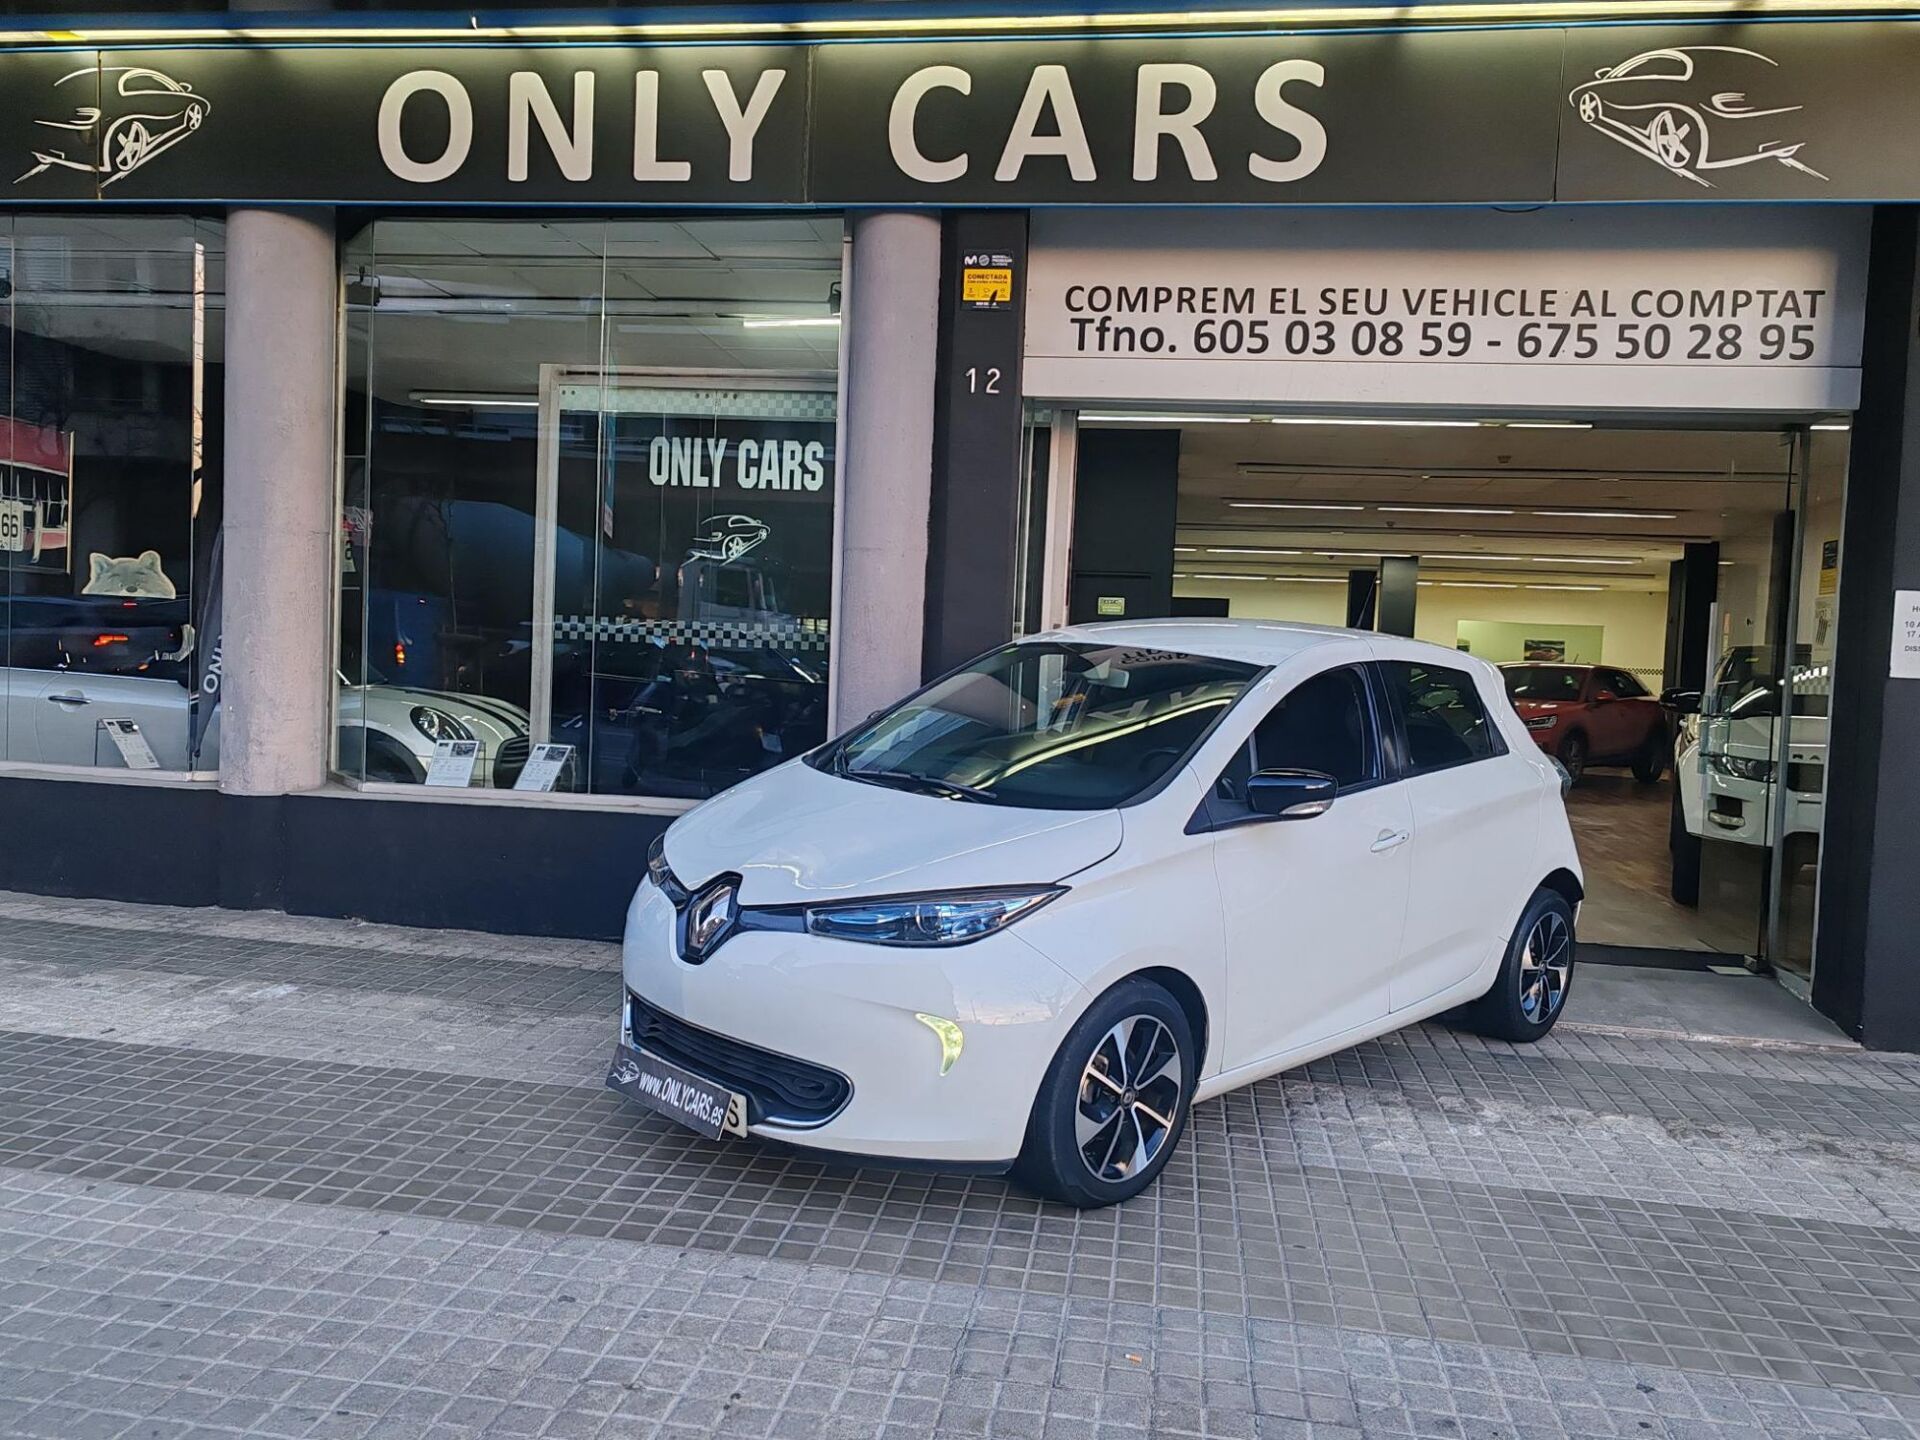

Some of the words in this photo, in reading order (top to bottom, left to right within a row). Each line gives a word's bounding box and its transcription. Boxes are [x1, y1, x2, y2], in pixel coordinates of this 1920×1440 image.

[378, 68, 786, 183] ONLY
[888, 60, 1327, 184] CARS
[1065, 285, 1255, 315] COMPREM
[1269, 287, 1307, 315] EL
[1318, 288, 1388, 316] SEU
[1402, 288, 1558, 317] VEHICLE
[1570, 290, 1617, 318] AL
[1631, 290, 1828, 320] COMPTAT
[1070, 317, 1177, 353] Tfno.
[1194, 319, 1269, 354] 605
[1285, 320, 1336, 355] 03
[1351, 321, 1404, 356] 08
[1419, 322, 1471, 357] 59
[1517, 322, 1598, 359] 675
[1615, 323, 1671, 360] 50
[1687, 324, 1742, 360] 28
[1759, 324, 1815, 361] 95
[965, 367, 1001, 394] 12
[649, 436, 728, 488] ONLY
[737, 439, 825, 492] CARS
[1907, 630, 1916, 638] 17
[638, 1071, 724, 1126] www.ONLYCARS.es
